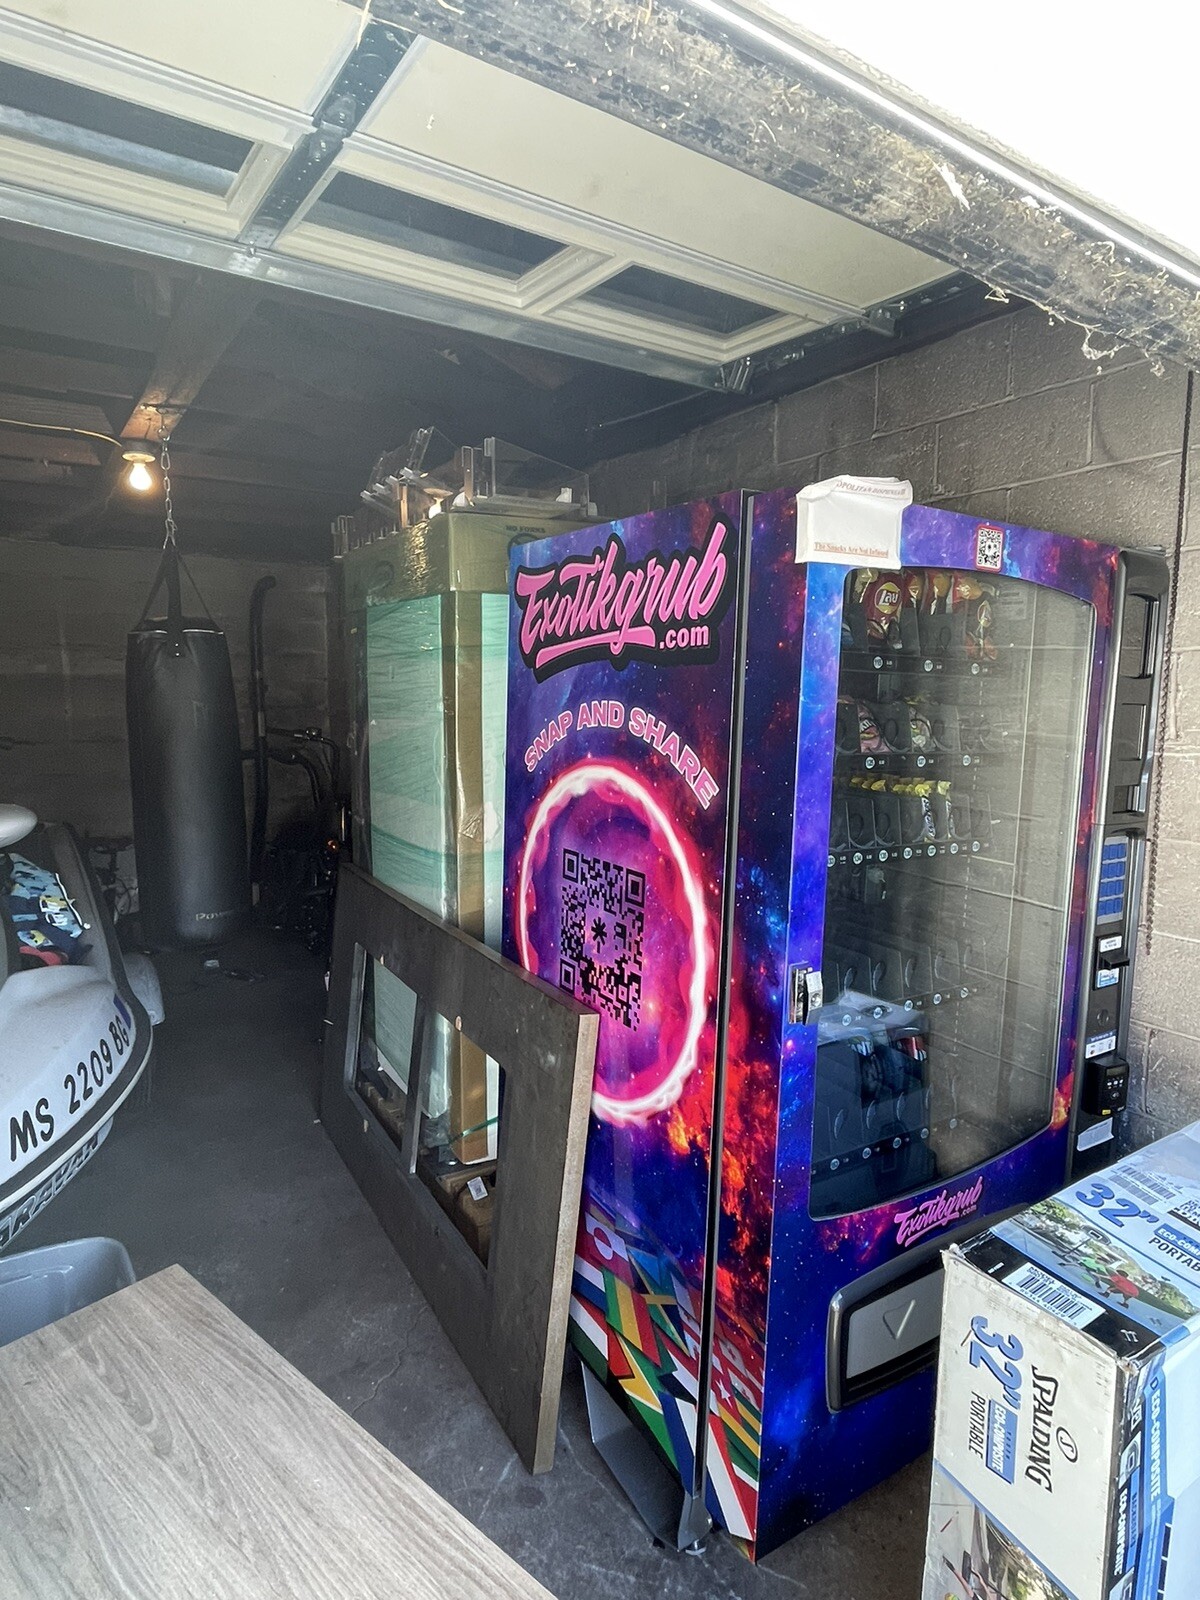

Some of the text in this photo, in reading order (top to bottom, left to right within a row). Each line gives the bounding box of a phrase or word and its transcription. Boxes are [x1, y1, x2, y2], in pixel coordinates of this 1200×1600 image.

[659, 624, 709, 650] .com
[524, 700, 720, 810] SNAP AND SHARE
[10, 1098, 54, 1162] MS
[64, 1039, 113, 1115] 2209
[108, 1014, 130, 1056] BG
[968, 1390, 986, 1460] PORTABLE
[991, 1404, 1007, 1474] ECO-COMPOSITE
[1025, 1364, 1059, 1493] SPALDING
[1151, 1388, 1161, 1501] ECO-COMPOSITE
